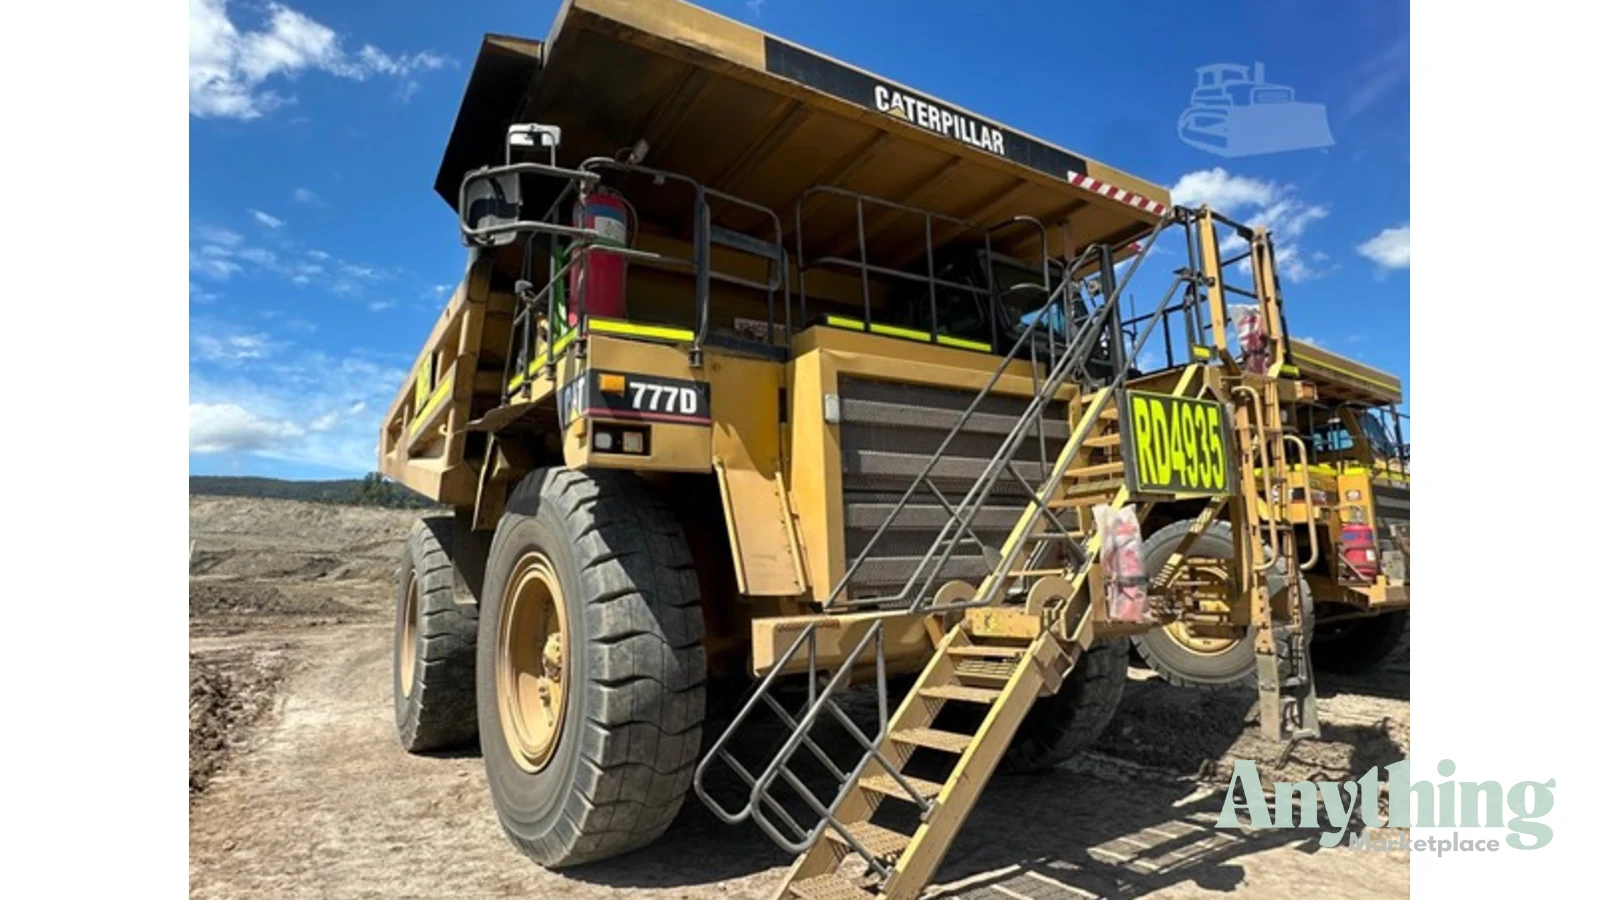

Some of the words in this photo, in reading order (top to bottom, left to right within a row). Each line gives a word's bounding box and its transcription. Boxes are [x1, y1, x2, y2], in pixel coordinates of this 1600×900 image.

[874, 85, 1005, 155] CATERPILLAR
[629, 381, 697, 414] 777D
[1133, 397, 1223, 489] RD4935
